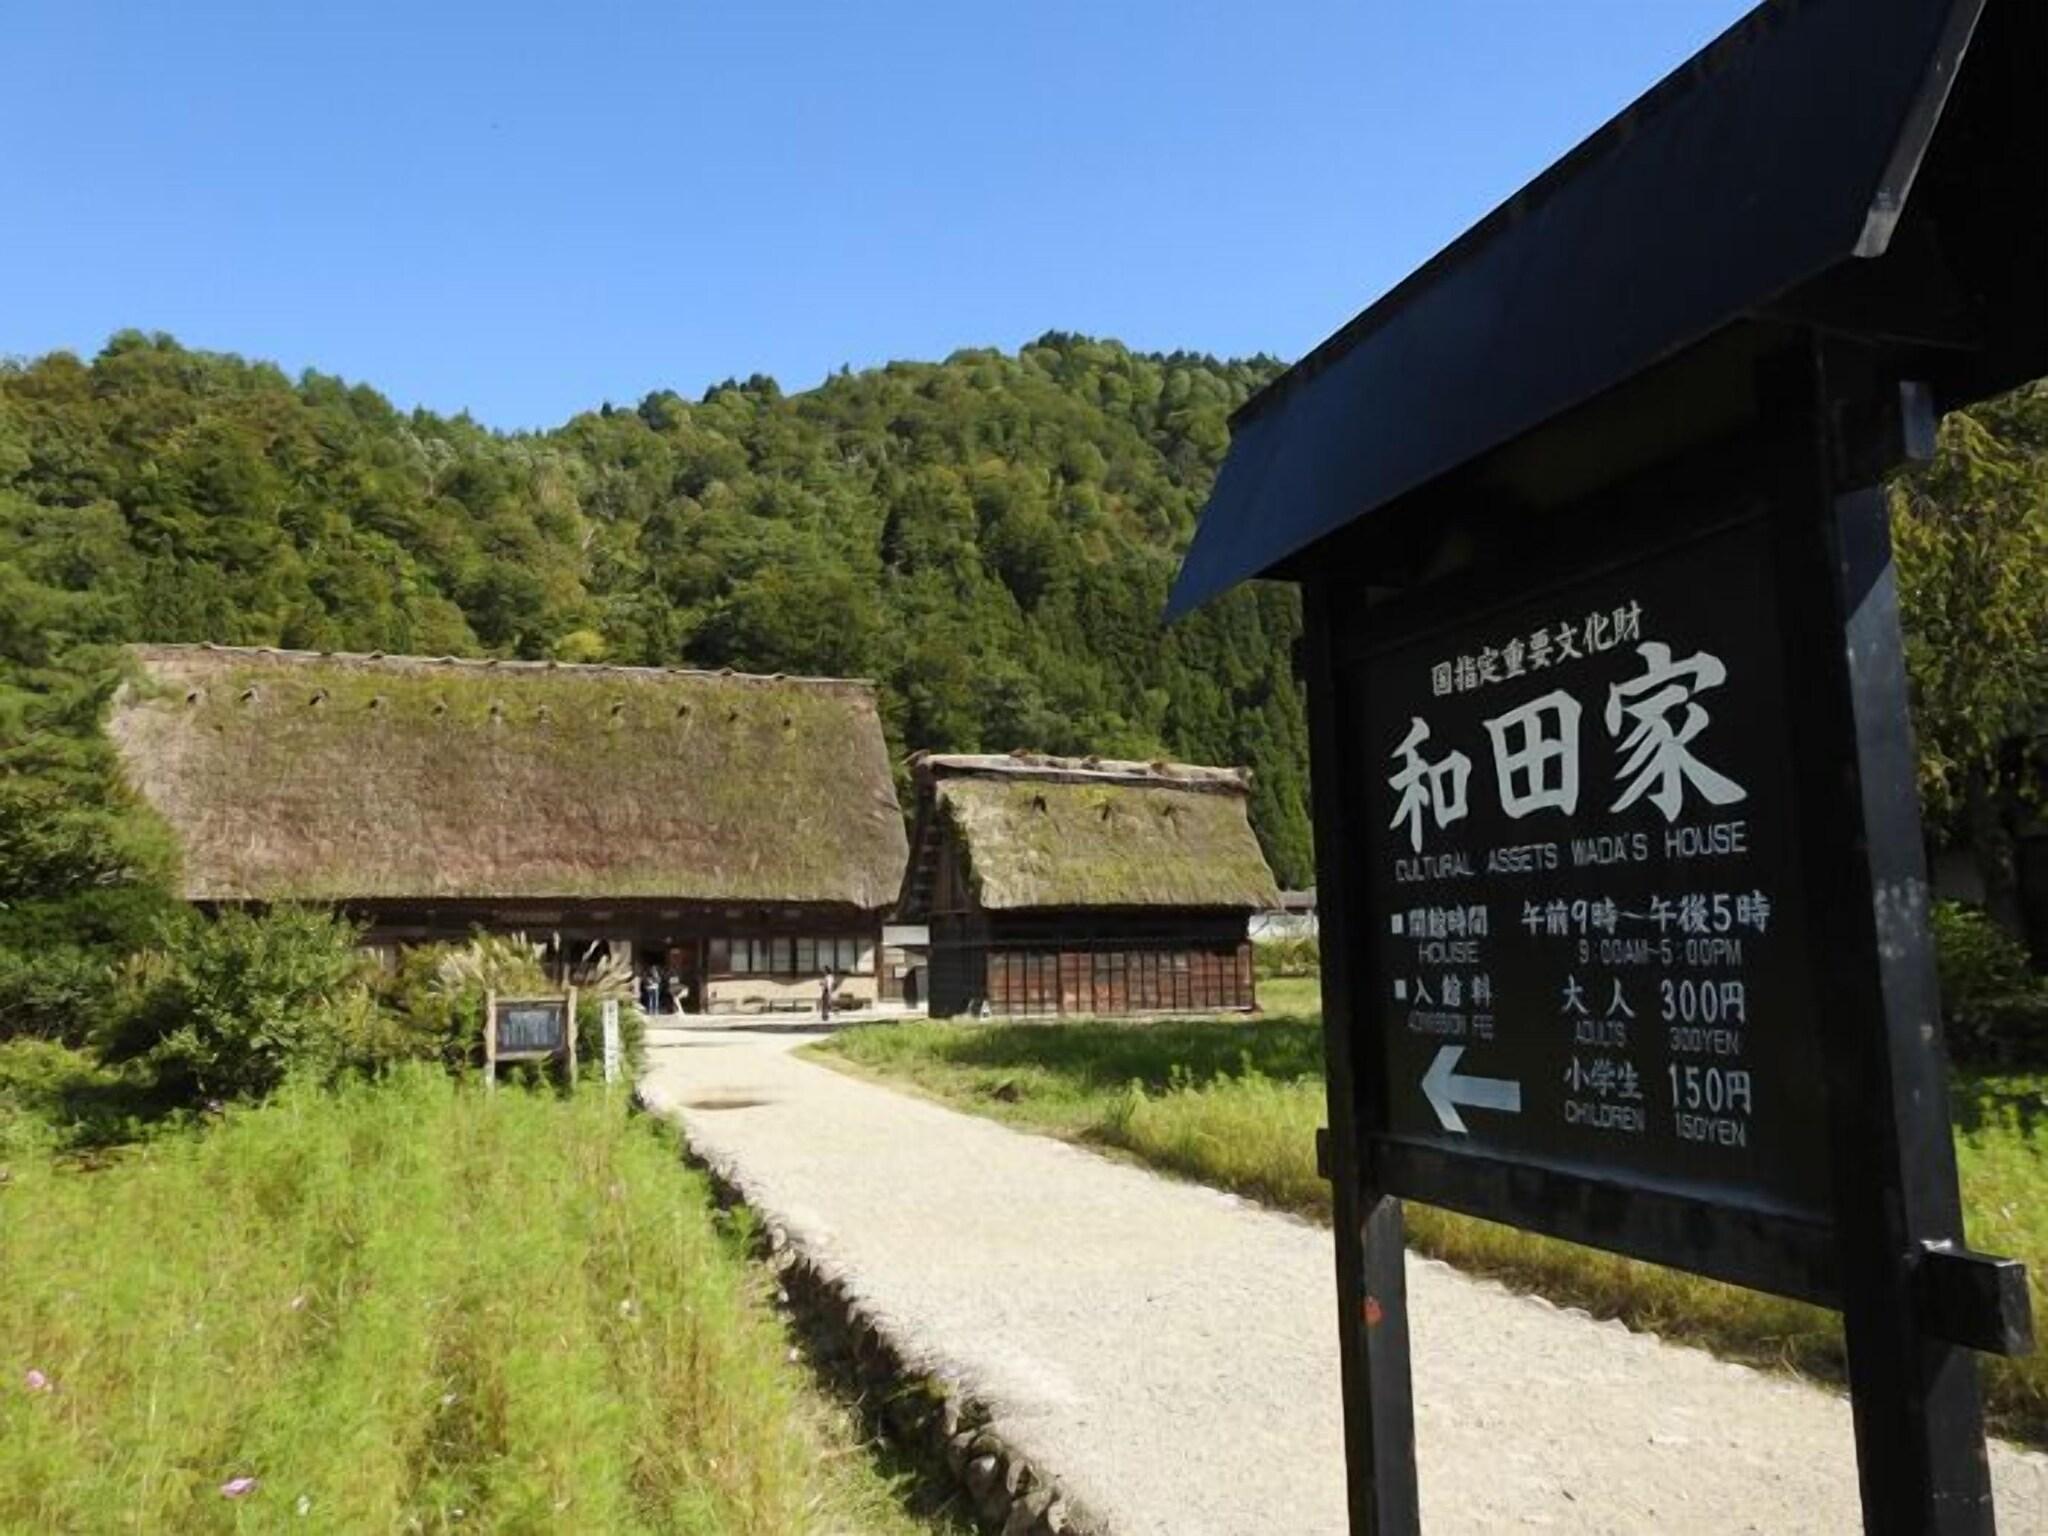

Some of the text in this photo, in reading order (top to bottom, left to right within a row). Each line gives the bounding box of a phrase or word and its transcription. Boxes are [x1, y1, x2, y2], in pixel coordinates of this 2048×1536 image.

[1431, 600, 1643, 696] 国指定重要文化財
[1388, 641, 1748, 853] 和田家
[1395, 820, 1748, 881] CULTURAL ASSETS WADA'S HOUSE
[1418, 940, 1481, 965] HOUSE
[1660, 979, 1746, 1025] 300円
[1563, 1056, 1752, 1115] 小学生 150円
[1564, 1099, 1646, 1132] CHILDREN
